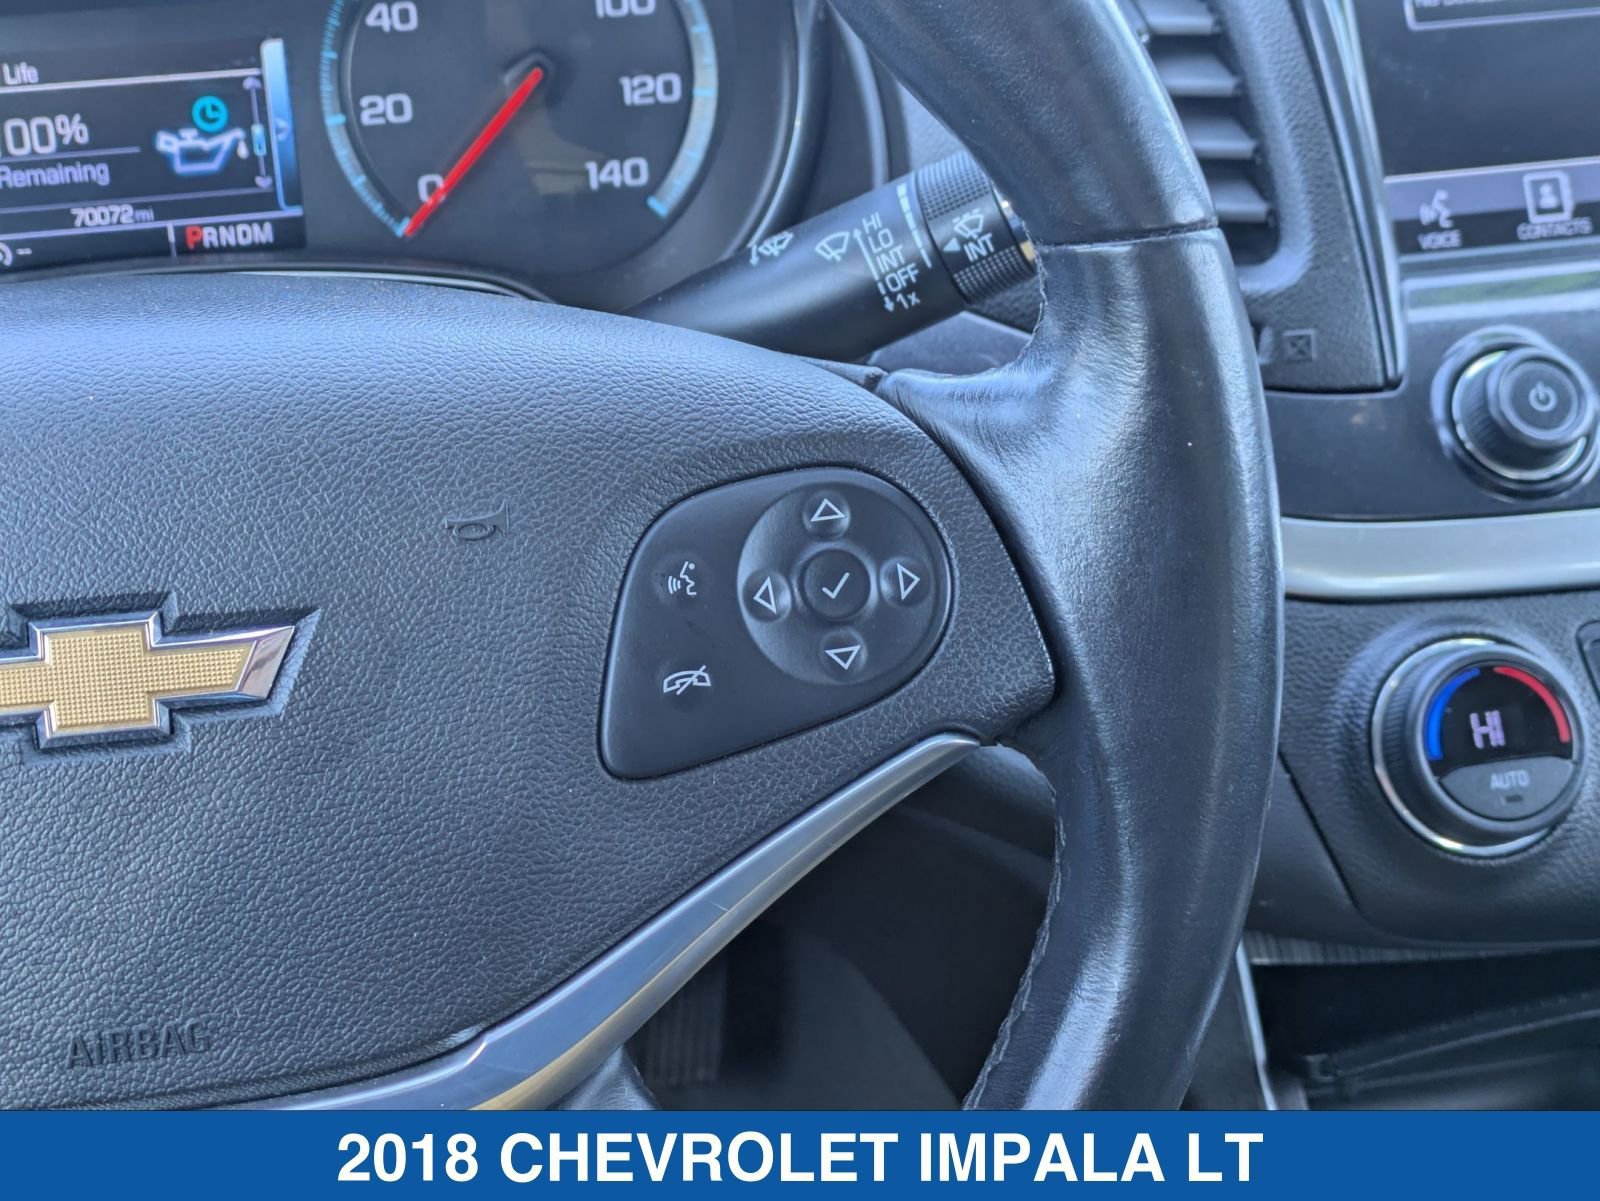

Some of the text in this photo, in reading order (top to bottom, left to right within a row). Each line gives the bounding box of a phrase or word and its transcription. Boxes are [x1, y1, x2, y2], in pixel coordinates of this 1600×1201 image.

[365, 1, 418, 33] 40
[2, 62, 39, 85] Life
[619, 72, 682, 106] 120
[360, 93, 413, 127] 20
[0, 113, 89, 156] 00%
[0, 161, 110, 189] Remaining
[585, 157, 649, 190] 140
[417, 174, 446, 205] 0
[862, 212, 882, 234] HI
[1516, 217, 1593, 241] CONTACTS
[867, 229, 894, 253] LO
[963, 233, 996, 262] INT
[1417, 229, 1462, 250] VOICE
[876, 245, 907, 273] INT
[884, 263, 920, 293] OFF
[1470, 710, 1506, 749] HI
[1490, 769, 1530, 790] AUTO
[66, 1017, 213, 1070] AIRBAG
